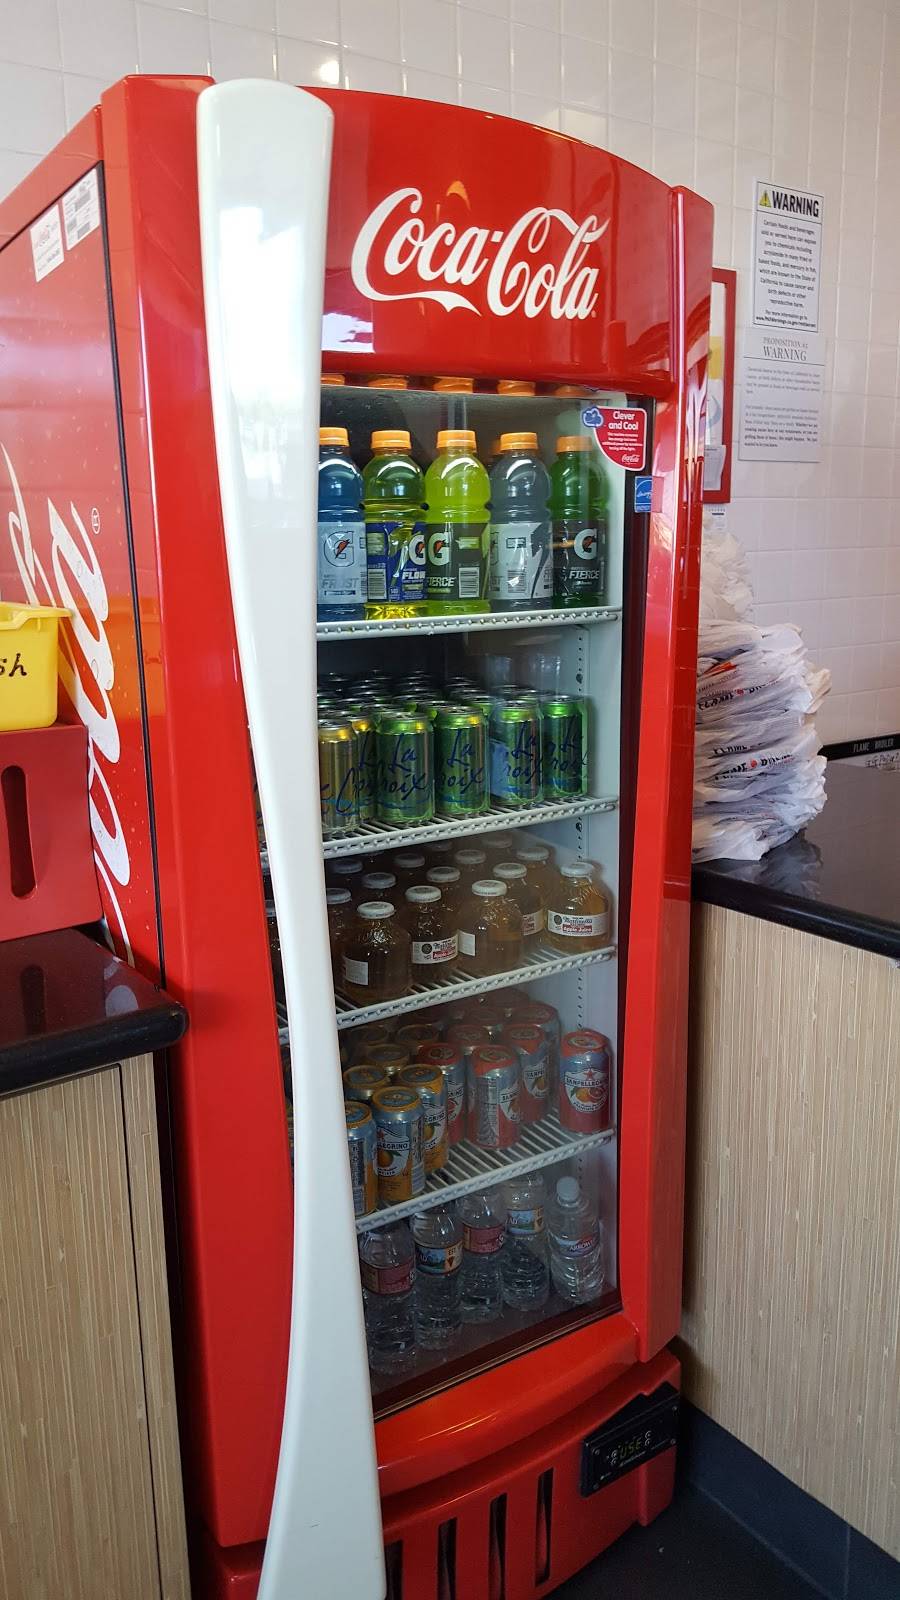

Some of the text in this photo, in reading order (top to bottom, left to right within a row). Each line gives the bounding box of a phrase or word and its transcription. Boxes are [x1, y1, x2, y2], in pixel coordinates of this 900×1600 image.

[771, 190, 819, 217] WARNING
[351, 187, 610, 320] Coca-Cola
[762, 346, 806, 361] WARNING
[608, 421, 639, 430] and Cool
[613, 411, 635, 420] Clever
[428, 533, 450, 566] G
[574, 528, 598, 560] G
[569, 570, 600, 580] FIERCE
[447, 728, 474, 768] La
